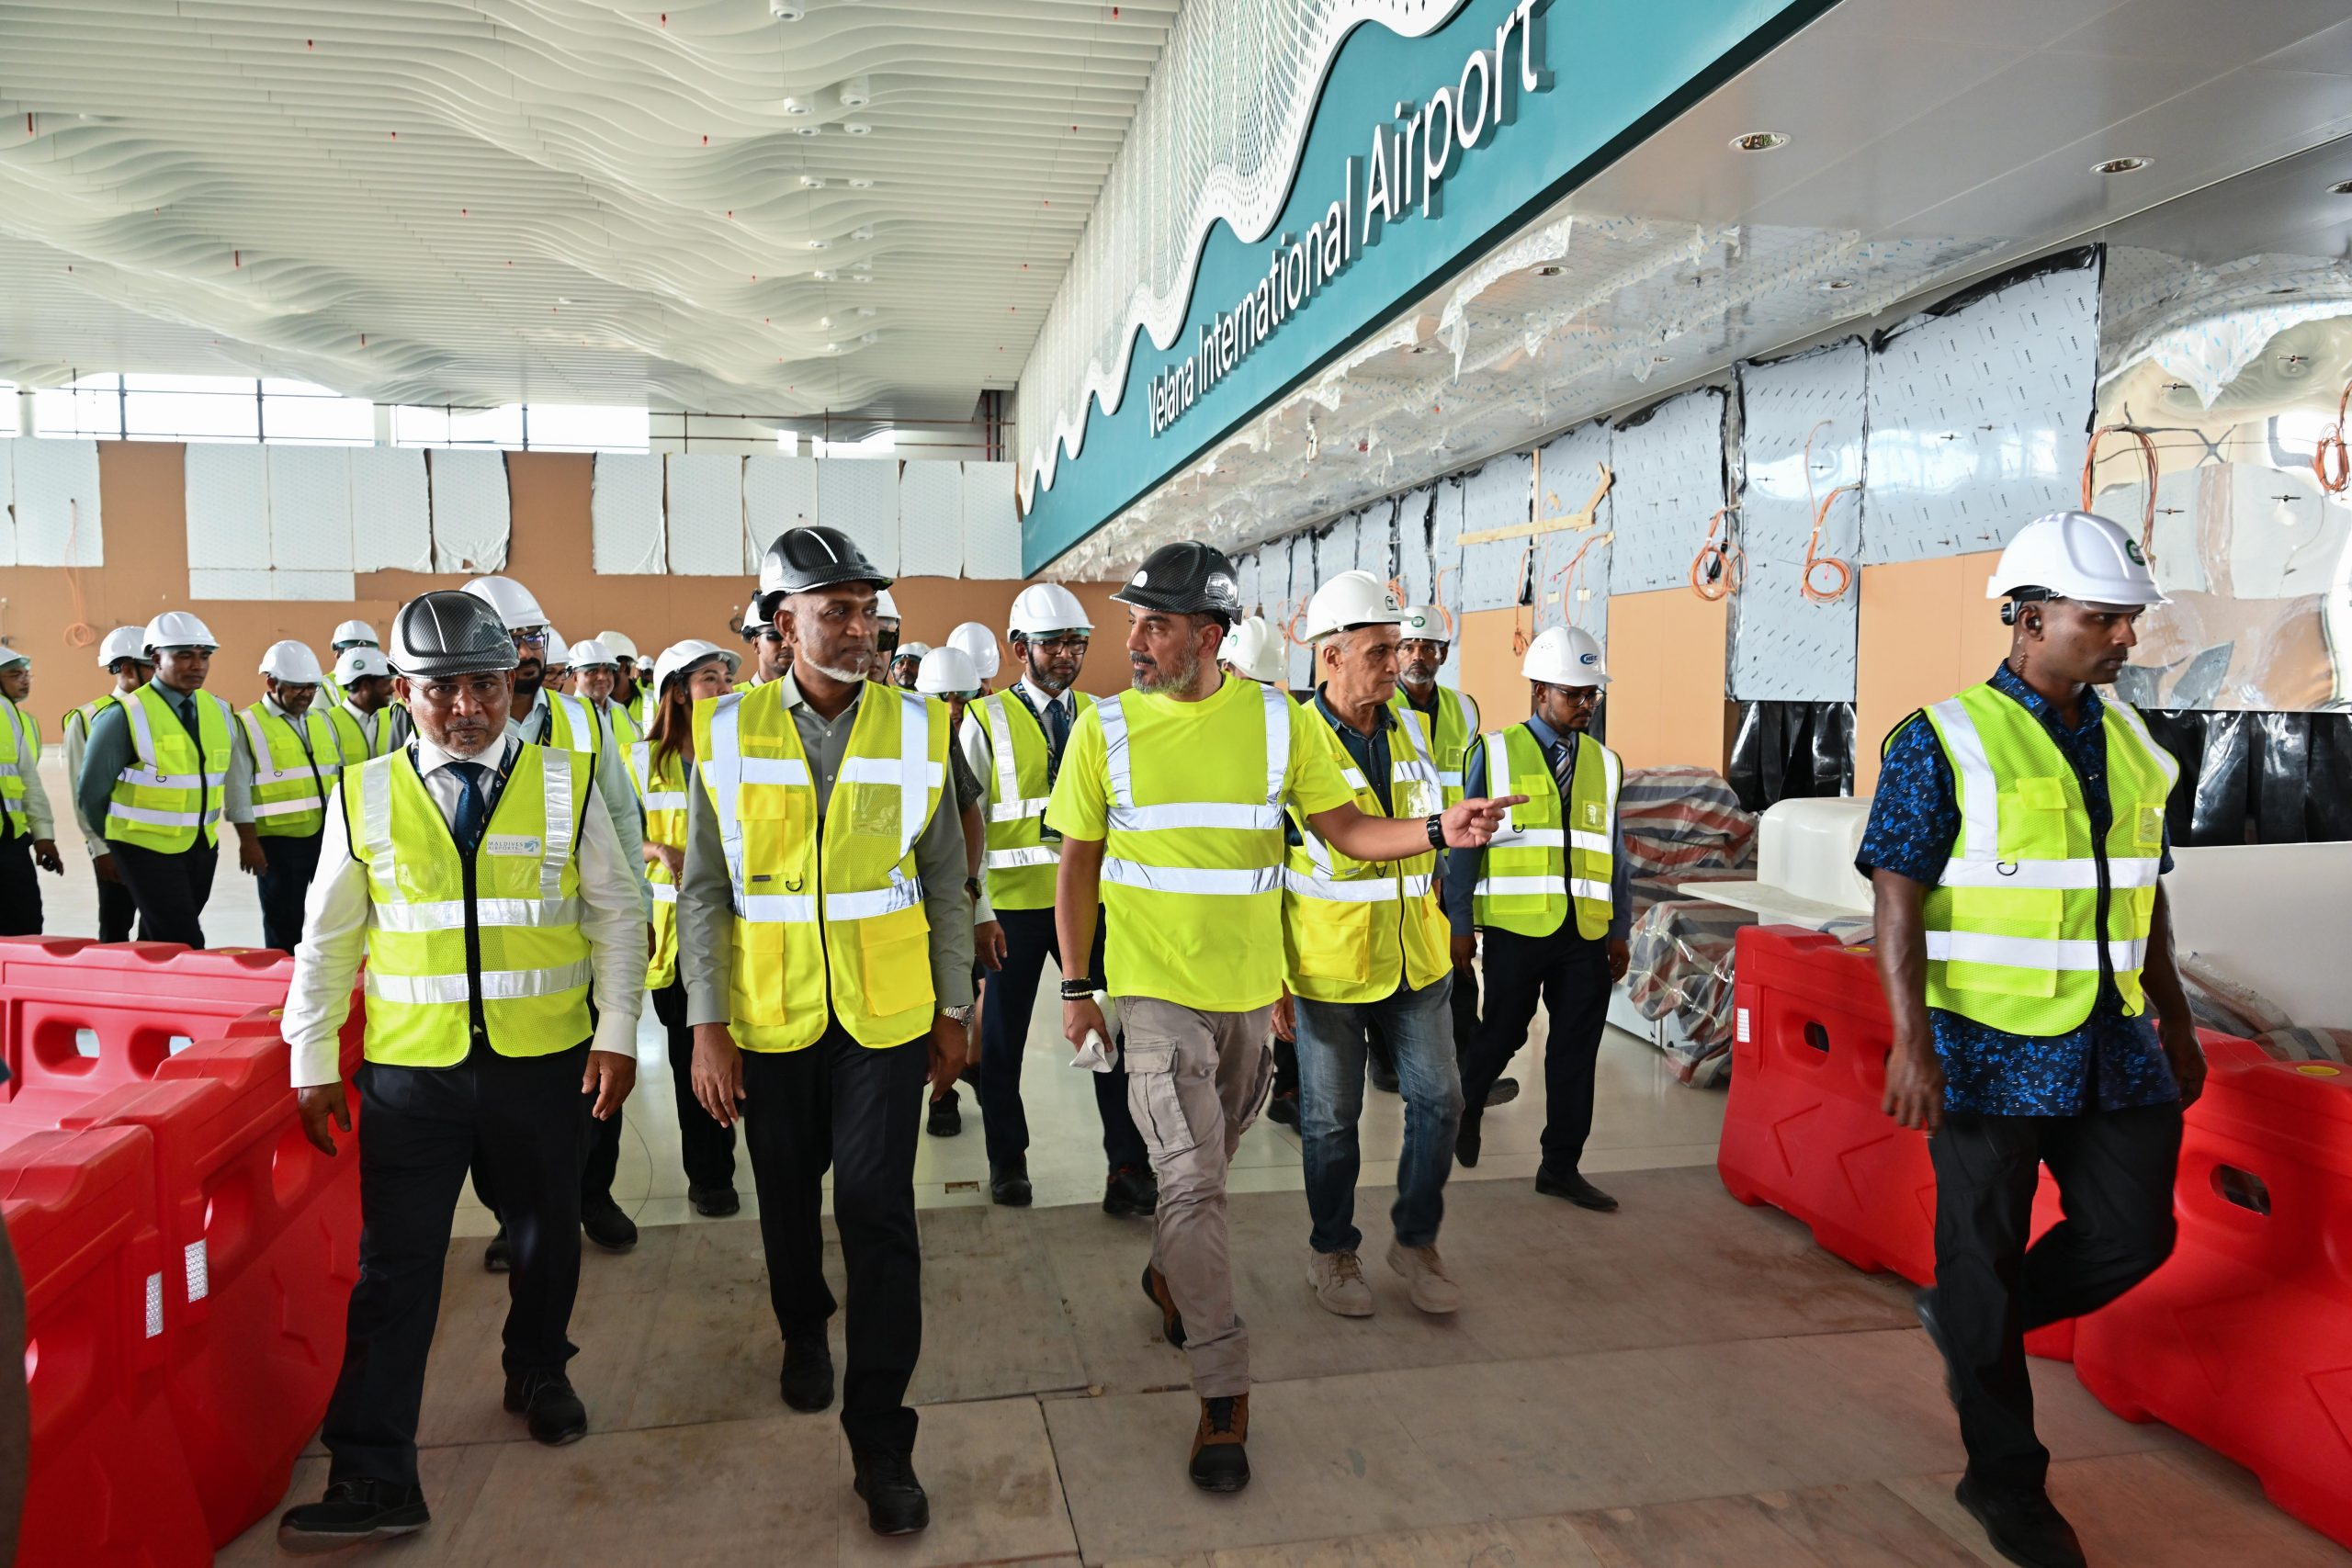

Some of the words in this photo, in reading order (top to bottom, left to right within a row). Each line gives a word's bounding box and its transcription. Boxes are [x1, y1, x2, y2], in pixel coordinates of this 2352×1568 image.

[1148, 355, 1194, 439] Velana
[1199, 156, 1352, 395] International
[1362, 0, 1539, 246] Airport
